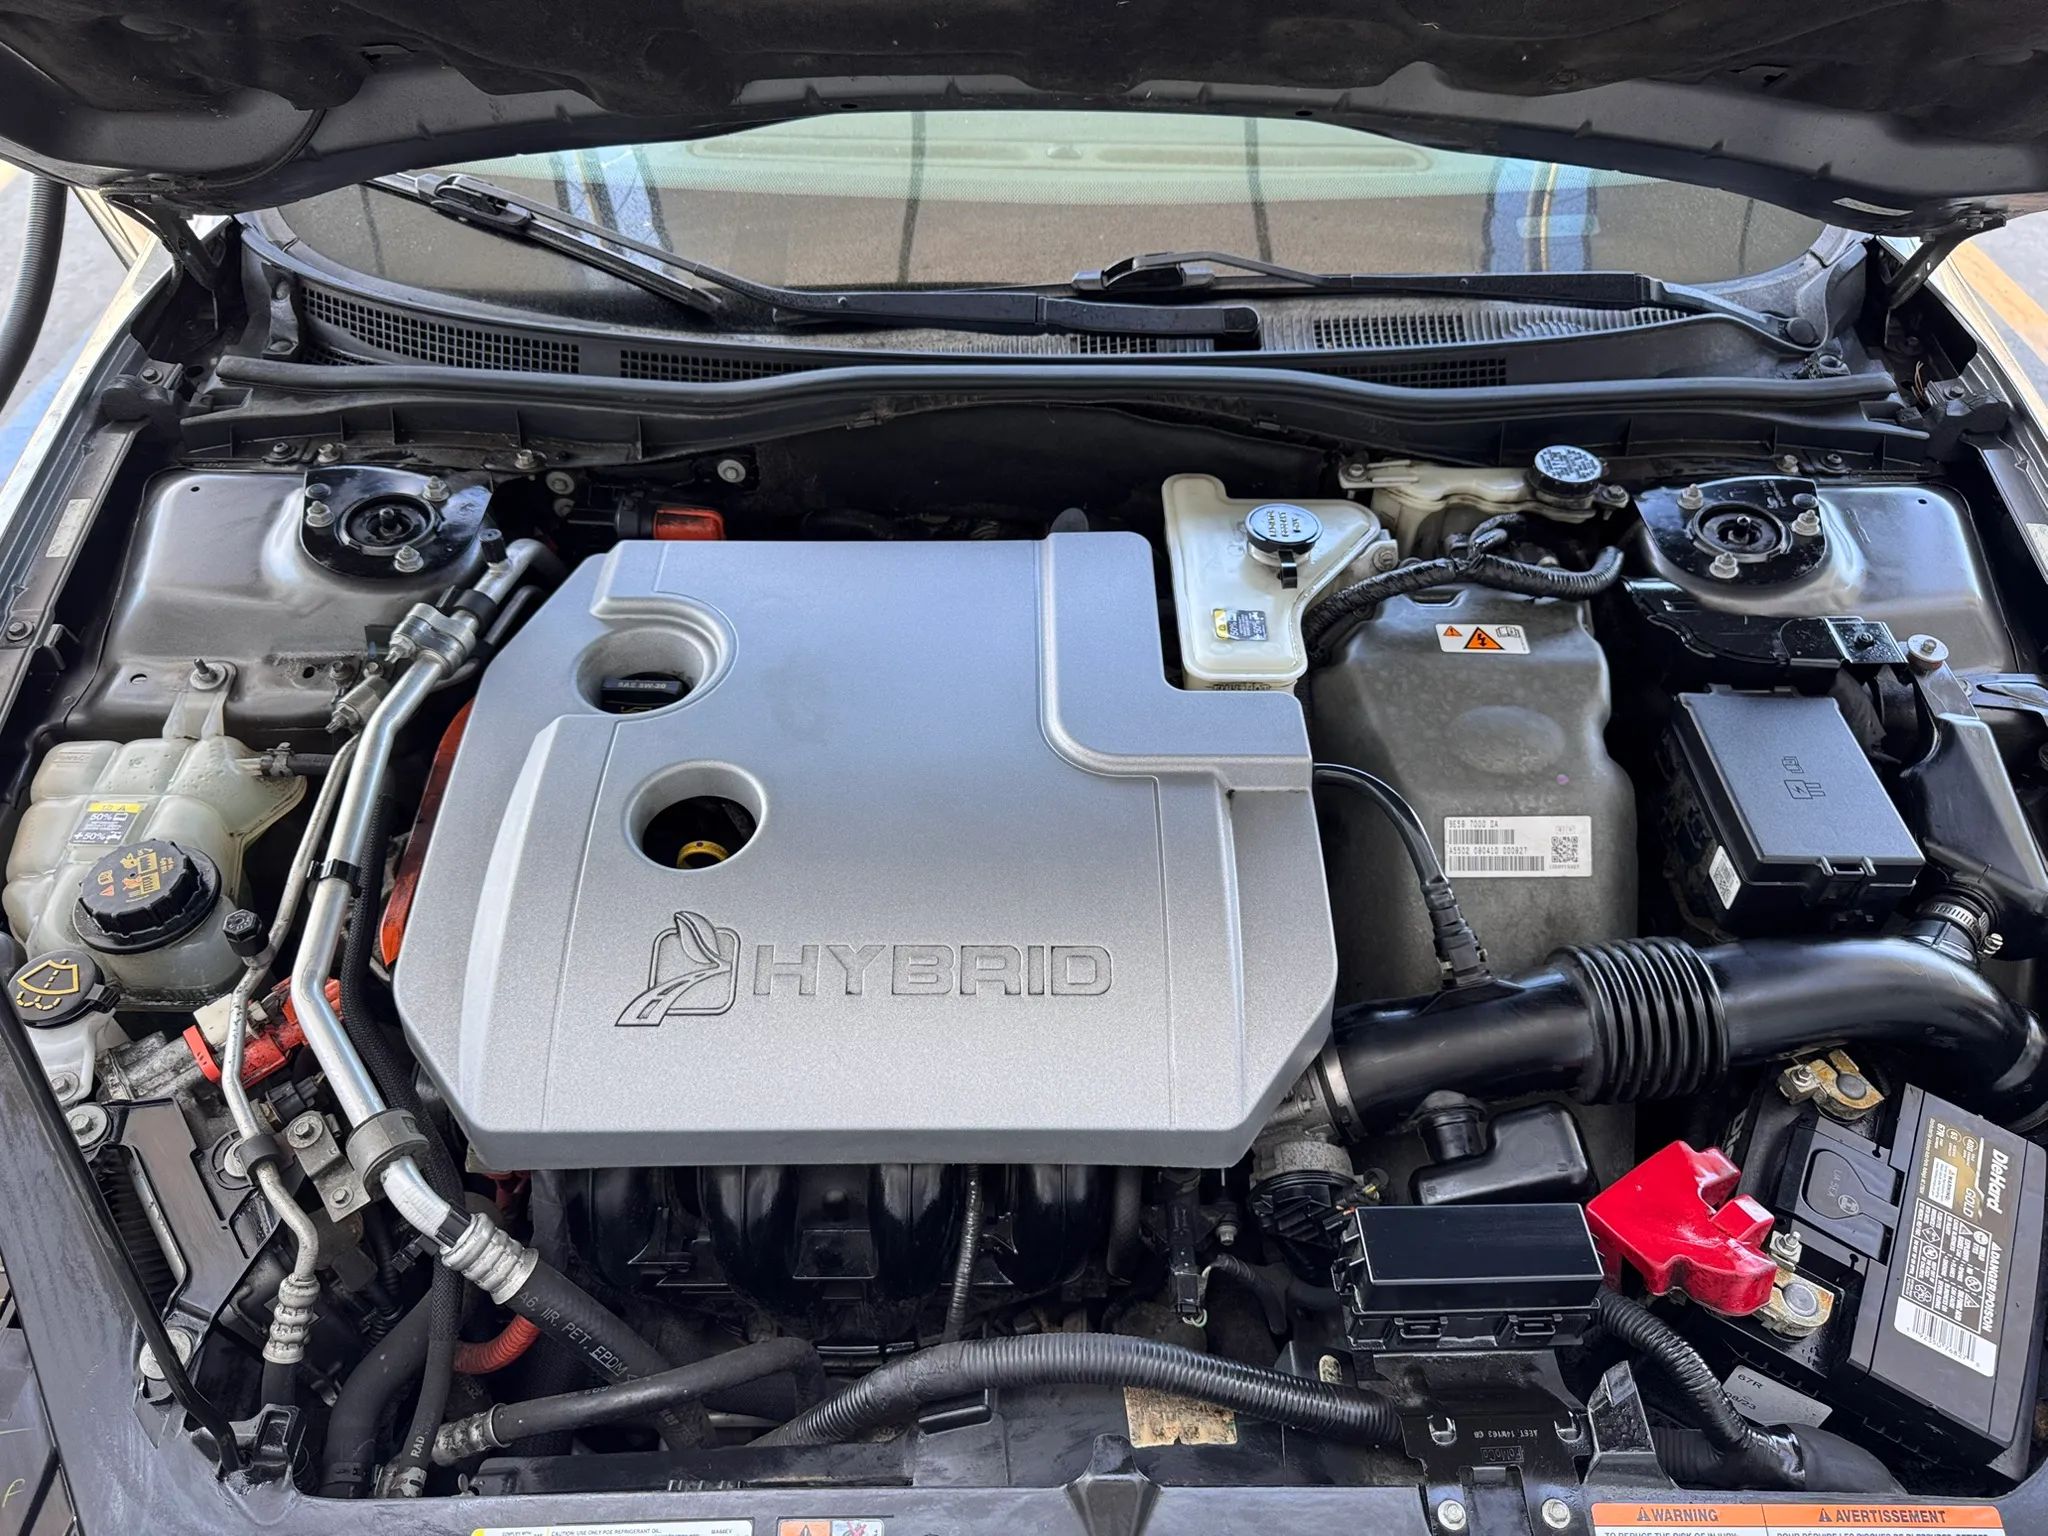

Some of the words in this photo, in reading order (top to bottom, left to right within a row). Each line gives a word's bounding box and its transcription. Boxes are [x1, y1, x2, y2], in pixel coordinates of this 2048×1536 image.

[753, 944, 1113, 996] HYBRID
[1935, 1123, 1945, 1137] 67R
[1986, 1148, 2008, 1214] DieHard
[1963, 1187, 1975, 1218] GOLD
[1981, 1250, 2000, 1332] DANGER/POISON
[590, 1345, 628, 1376] EPDM
[1737, 1373, 1763, 1389] 67R
[410, 1435, 425, 1458] RAD
[1482, 1447, 1523, 1462] FoMoCo
[1651, 1508, 1719, 1522] WARNING
[1836, 1509, 1946, 1523] AVERTISSEMENT
